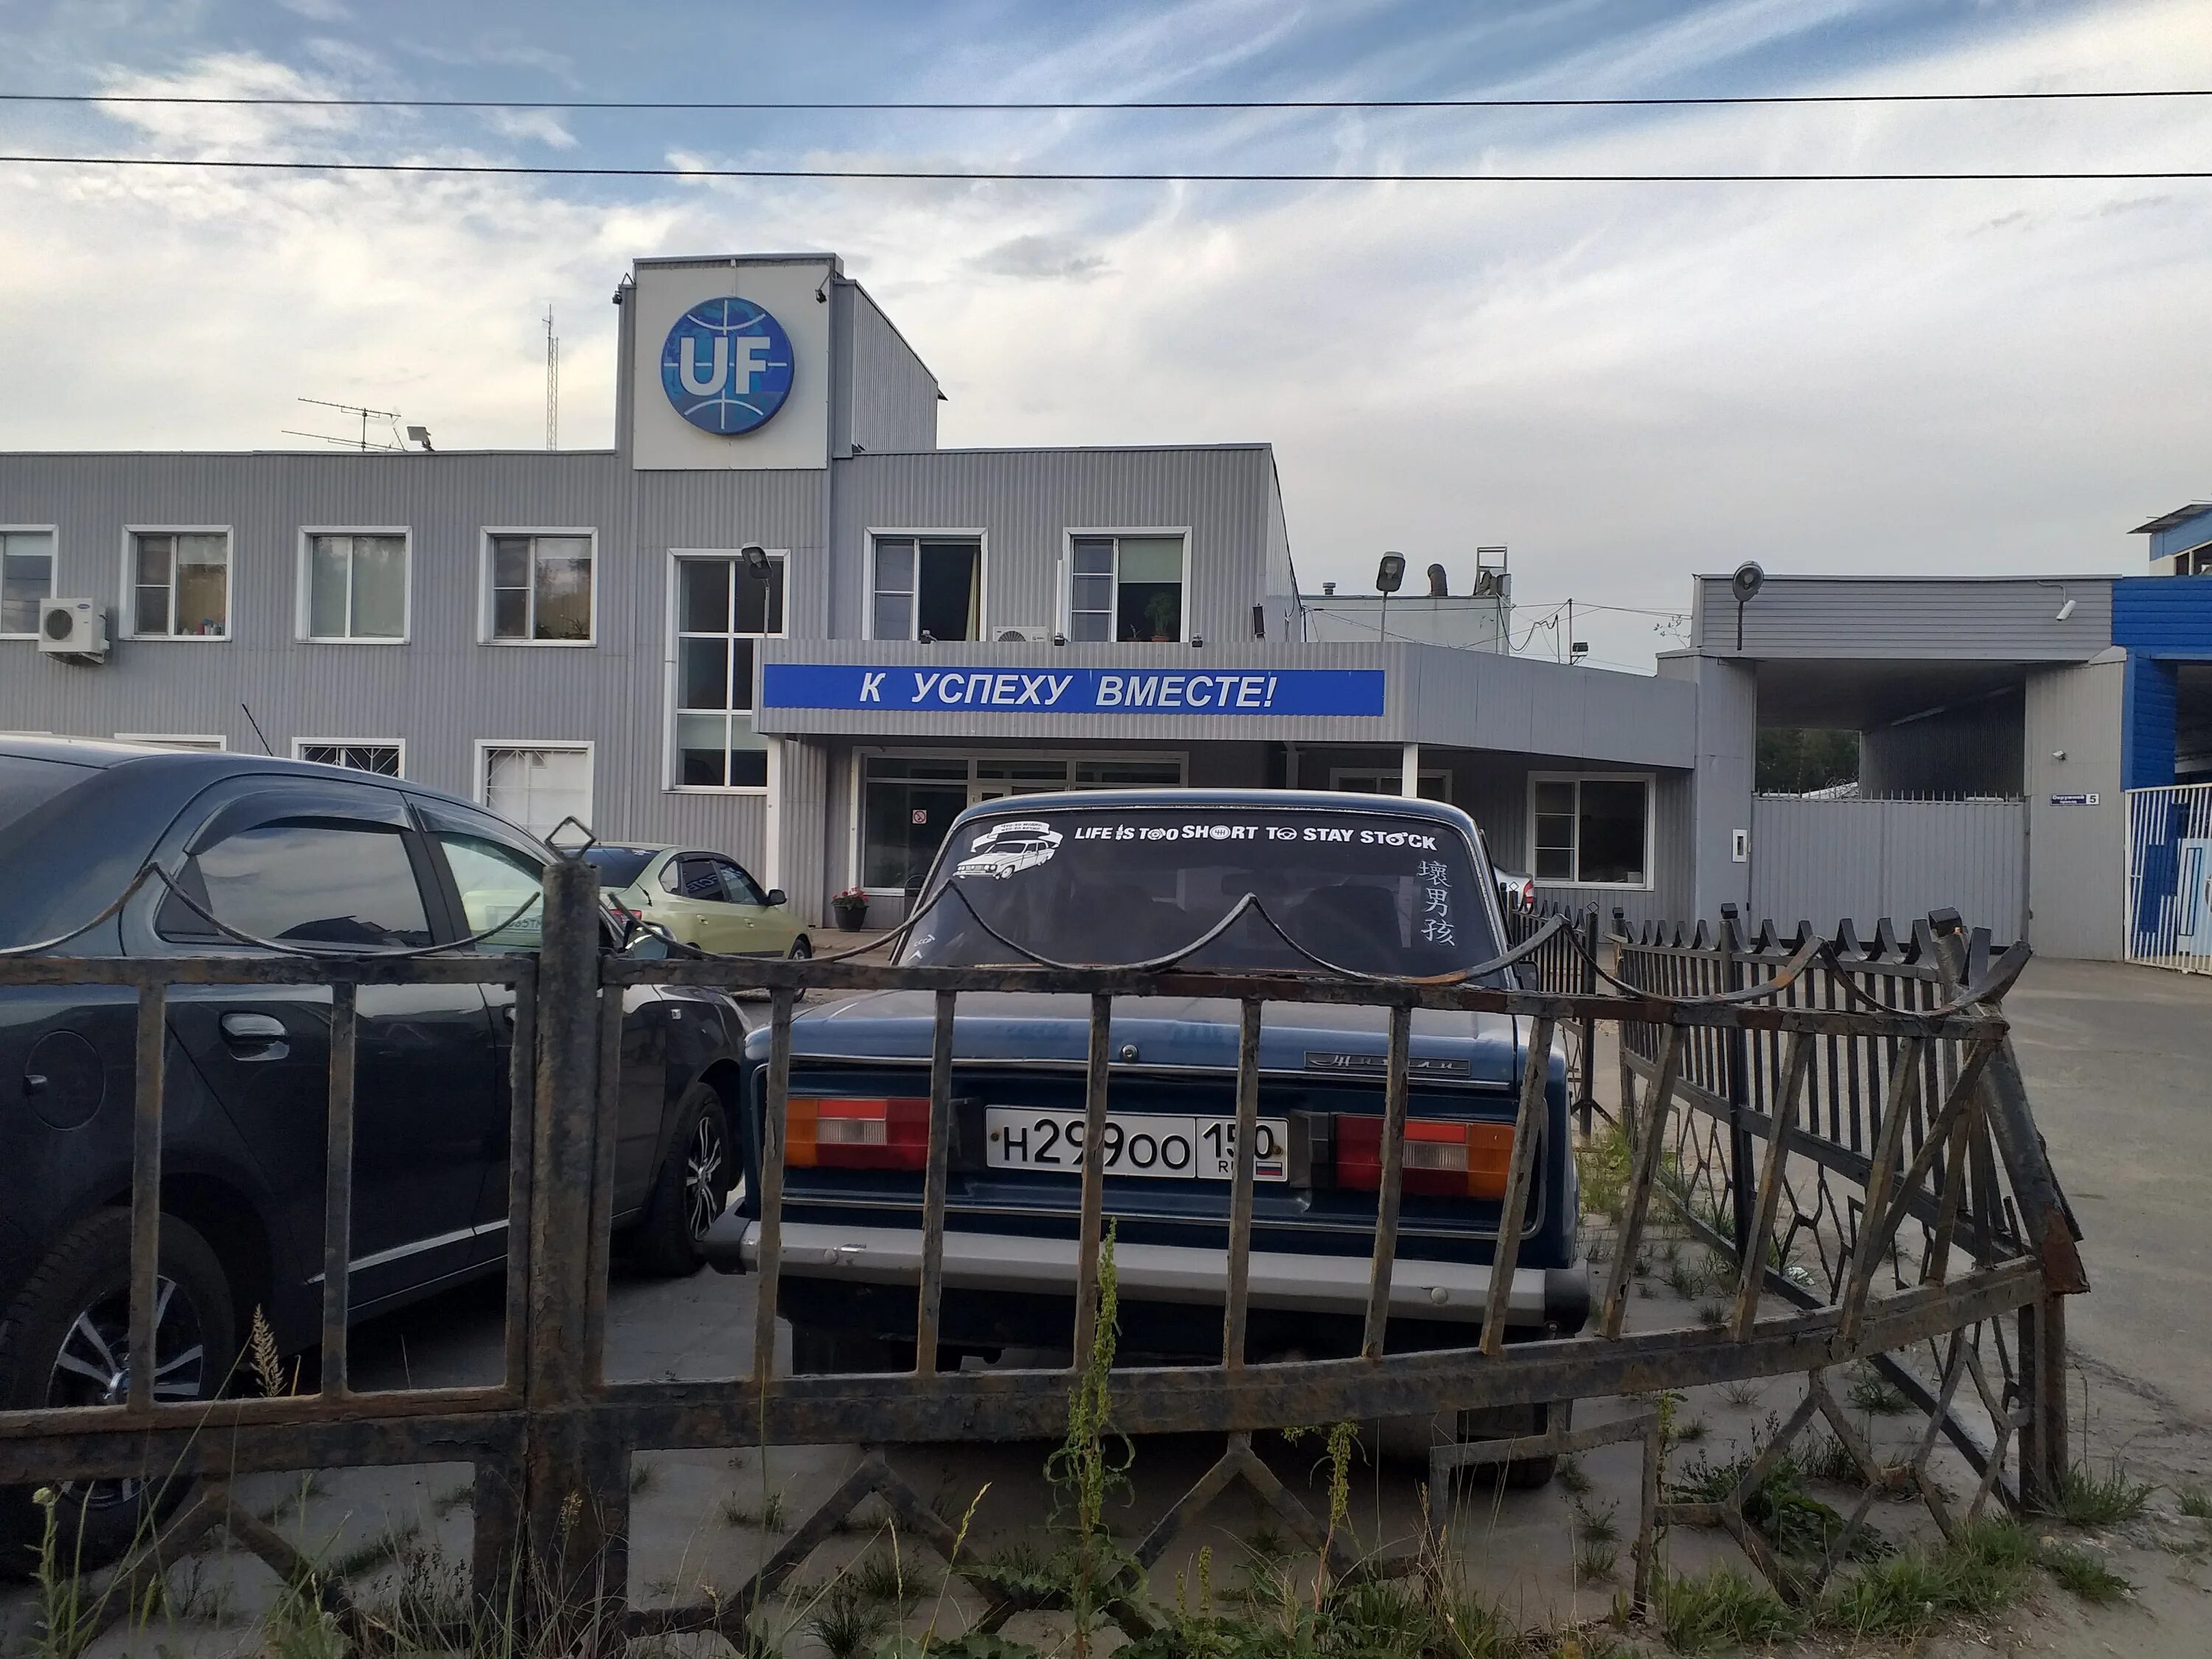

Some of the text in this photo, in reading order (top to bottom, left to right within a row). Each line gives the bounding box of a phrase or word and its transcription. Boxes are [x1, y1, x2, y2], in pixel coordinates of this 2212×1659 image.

[680, 336, 771, 396] UF
[859, 672, 1278, 708] К УСПЕХУ ВМЕСТЕ!
[2089, 795, 2096, 803] 5
[1074, 827, 1113, 840] LIFE
[1139, 827, 1179, 841] TOO
[1181, 825, 1259, 840] SHORT
[1266, 827, 1298, 841] TO
[1303, 827, 1354, 842] STAY
[1360, 830, 1438, 851] STOCK
[1416, 860, 1456, 947] 壞男孩
[1310, 1054, 1467, 1070] Жили
